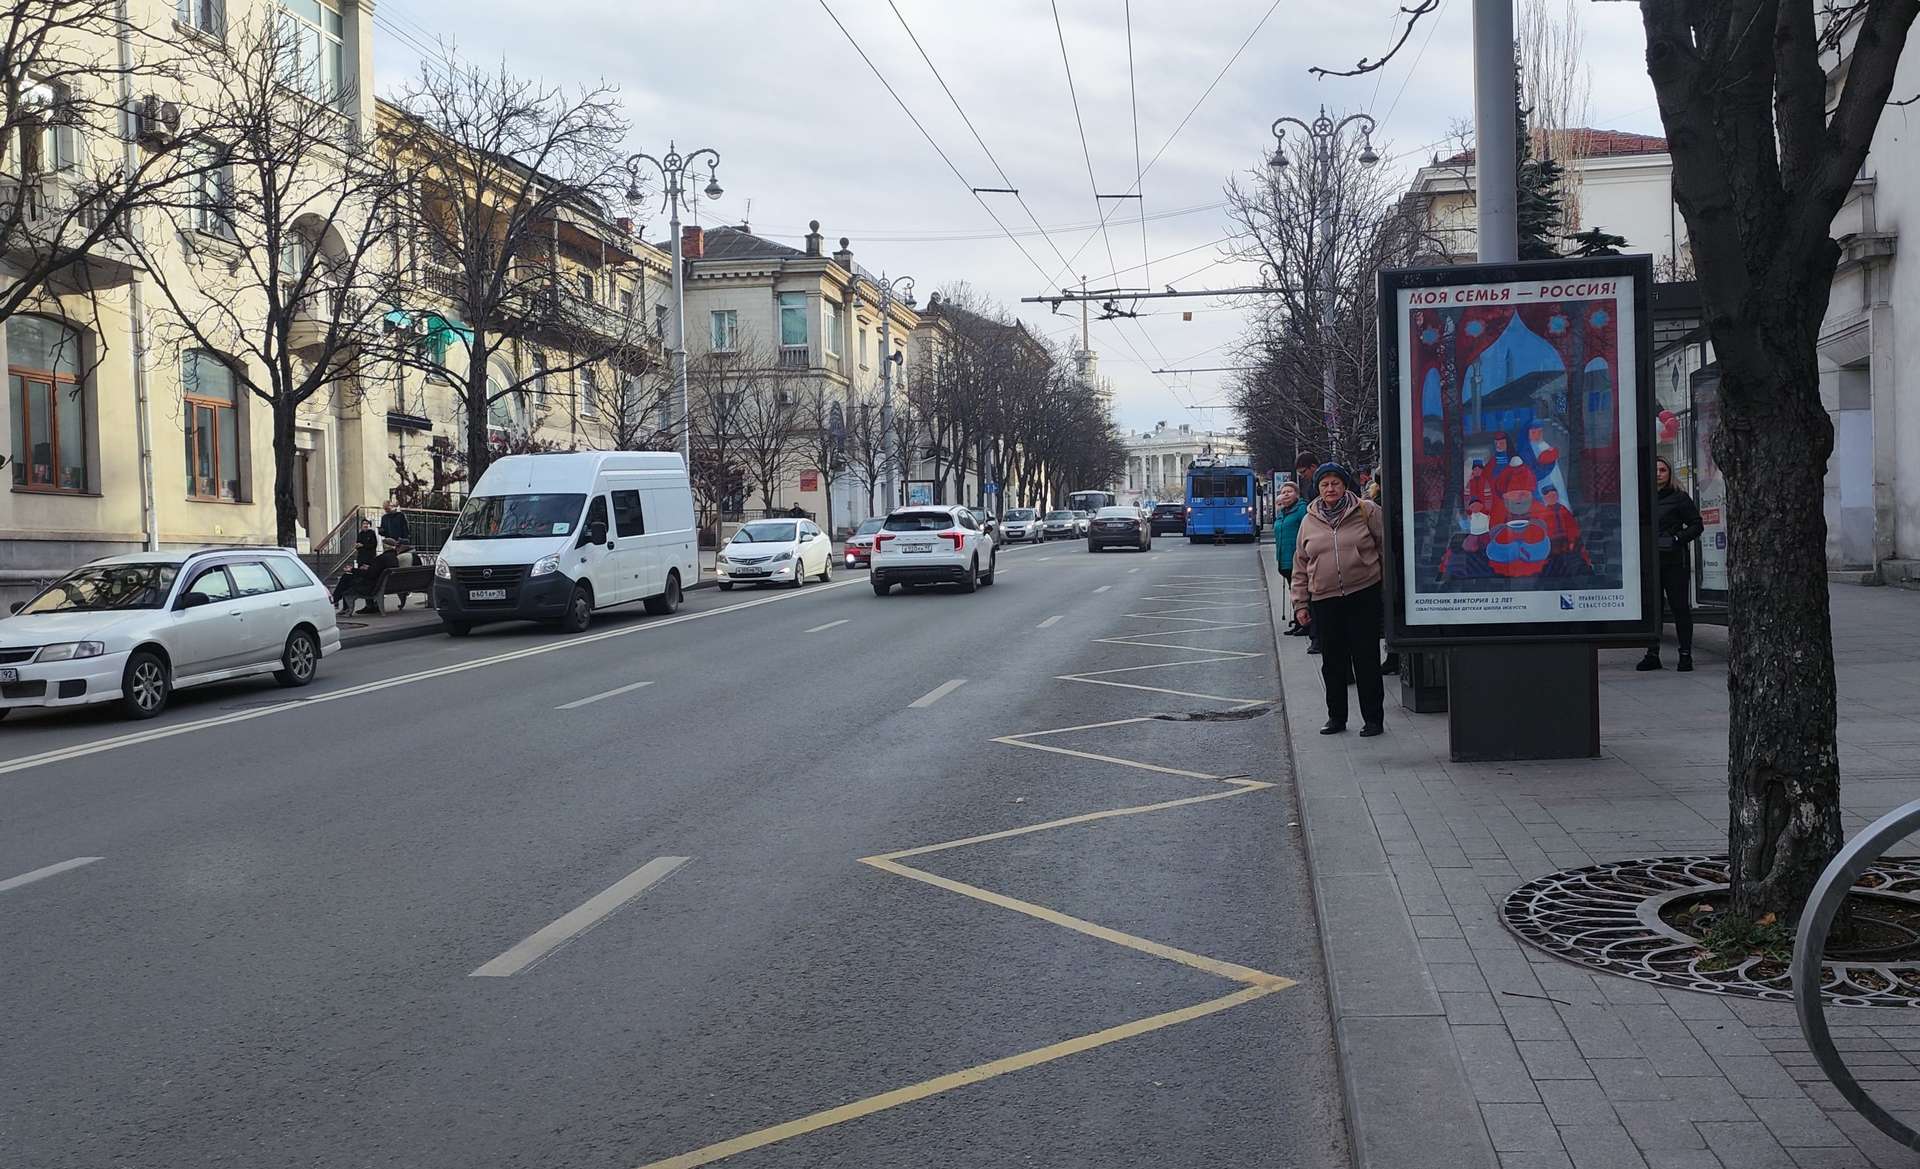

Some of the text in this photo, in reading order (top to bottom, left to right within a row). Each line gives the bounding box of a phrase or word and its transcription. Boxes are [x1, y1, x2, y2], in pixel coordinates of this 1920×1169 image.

[1409, 291, 1448, 305] МОЯ
[1455, 288, 1511, 302] СЕМЬЯ
[1540, 282, 1617, 298] РОССИЯ!
